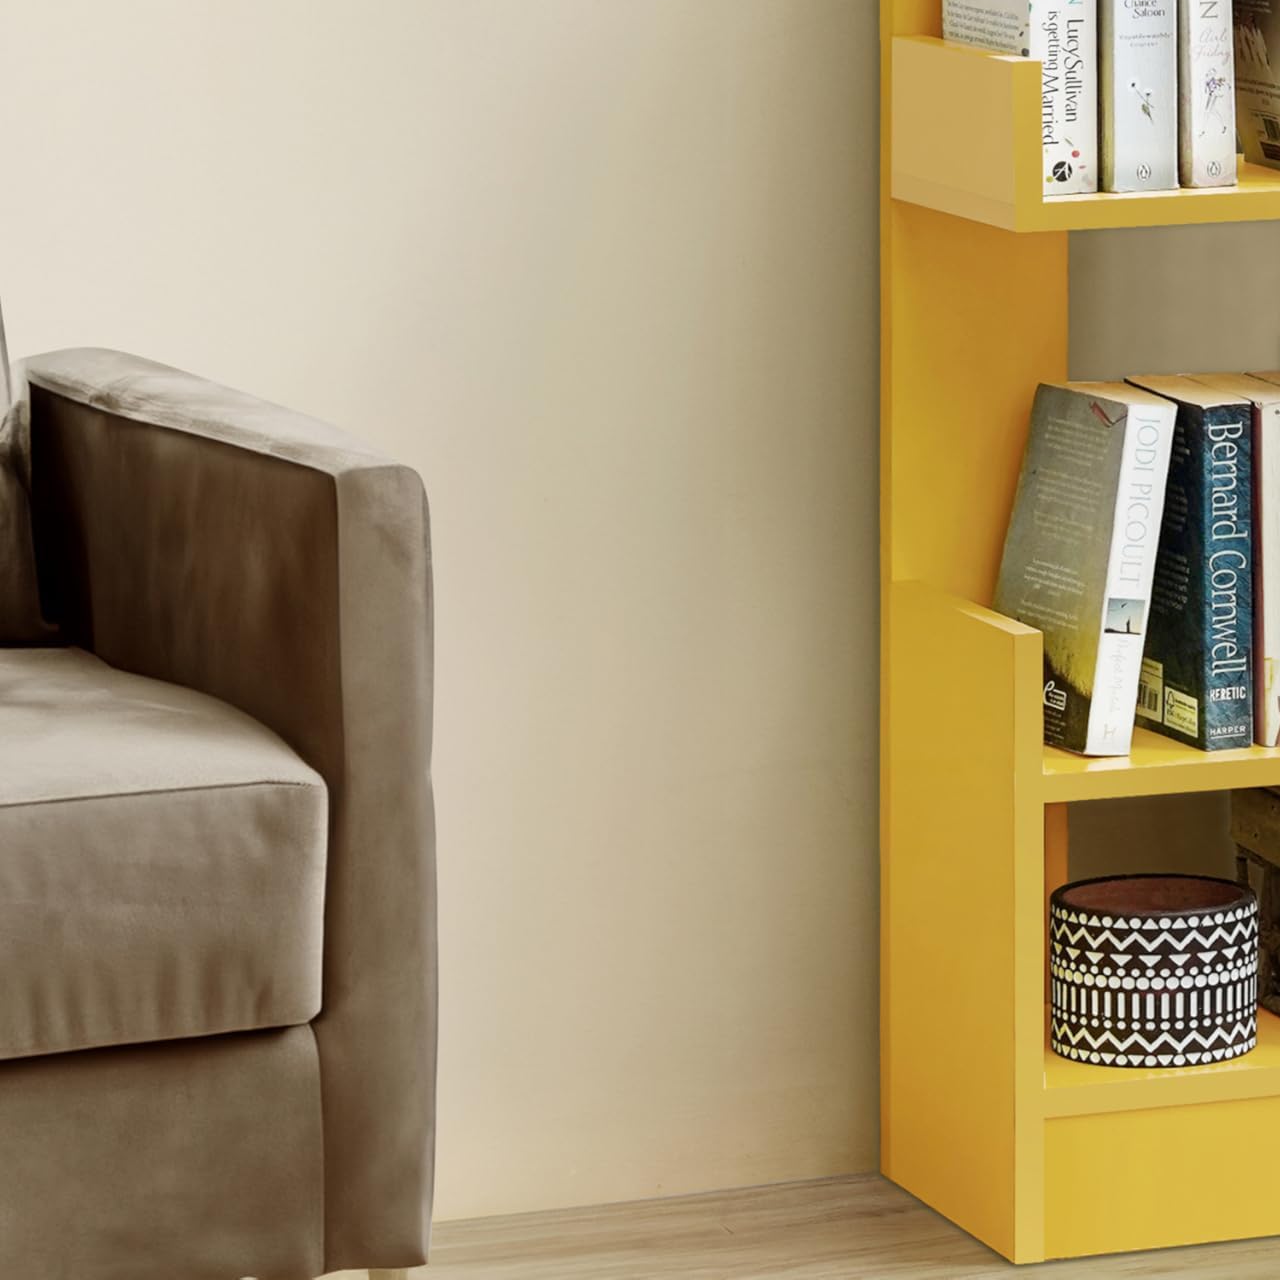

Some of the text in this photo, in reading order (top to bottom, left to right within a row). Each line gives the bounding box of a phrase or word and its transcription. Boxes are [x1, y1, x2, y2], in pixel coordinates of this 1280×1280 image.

[1132, 7, 1166, 19] Saloon
[1042, 72, 1060, 146] Married
[1119, 416, 1161, 588] JODI PICOULT
[1208, 421, 1249, 677] Bernard Cornwell
[1209, 726, 1247, 735] HARPER
